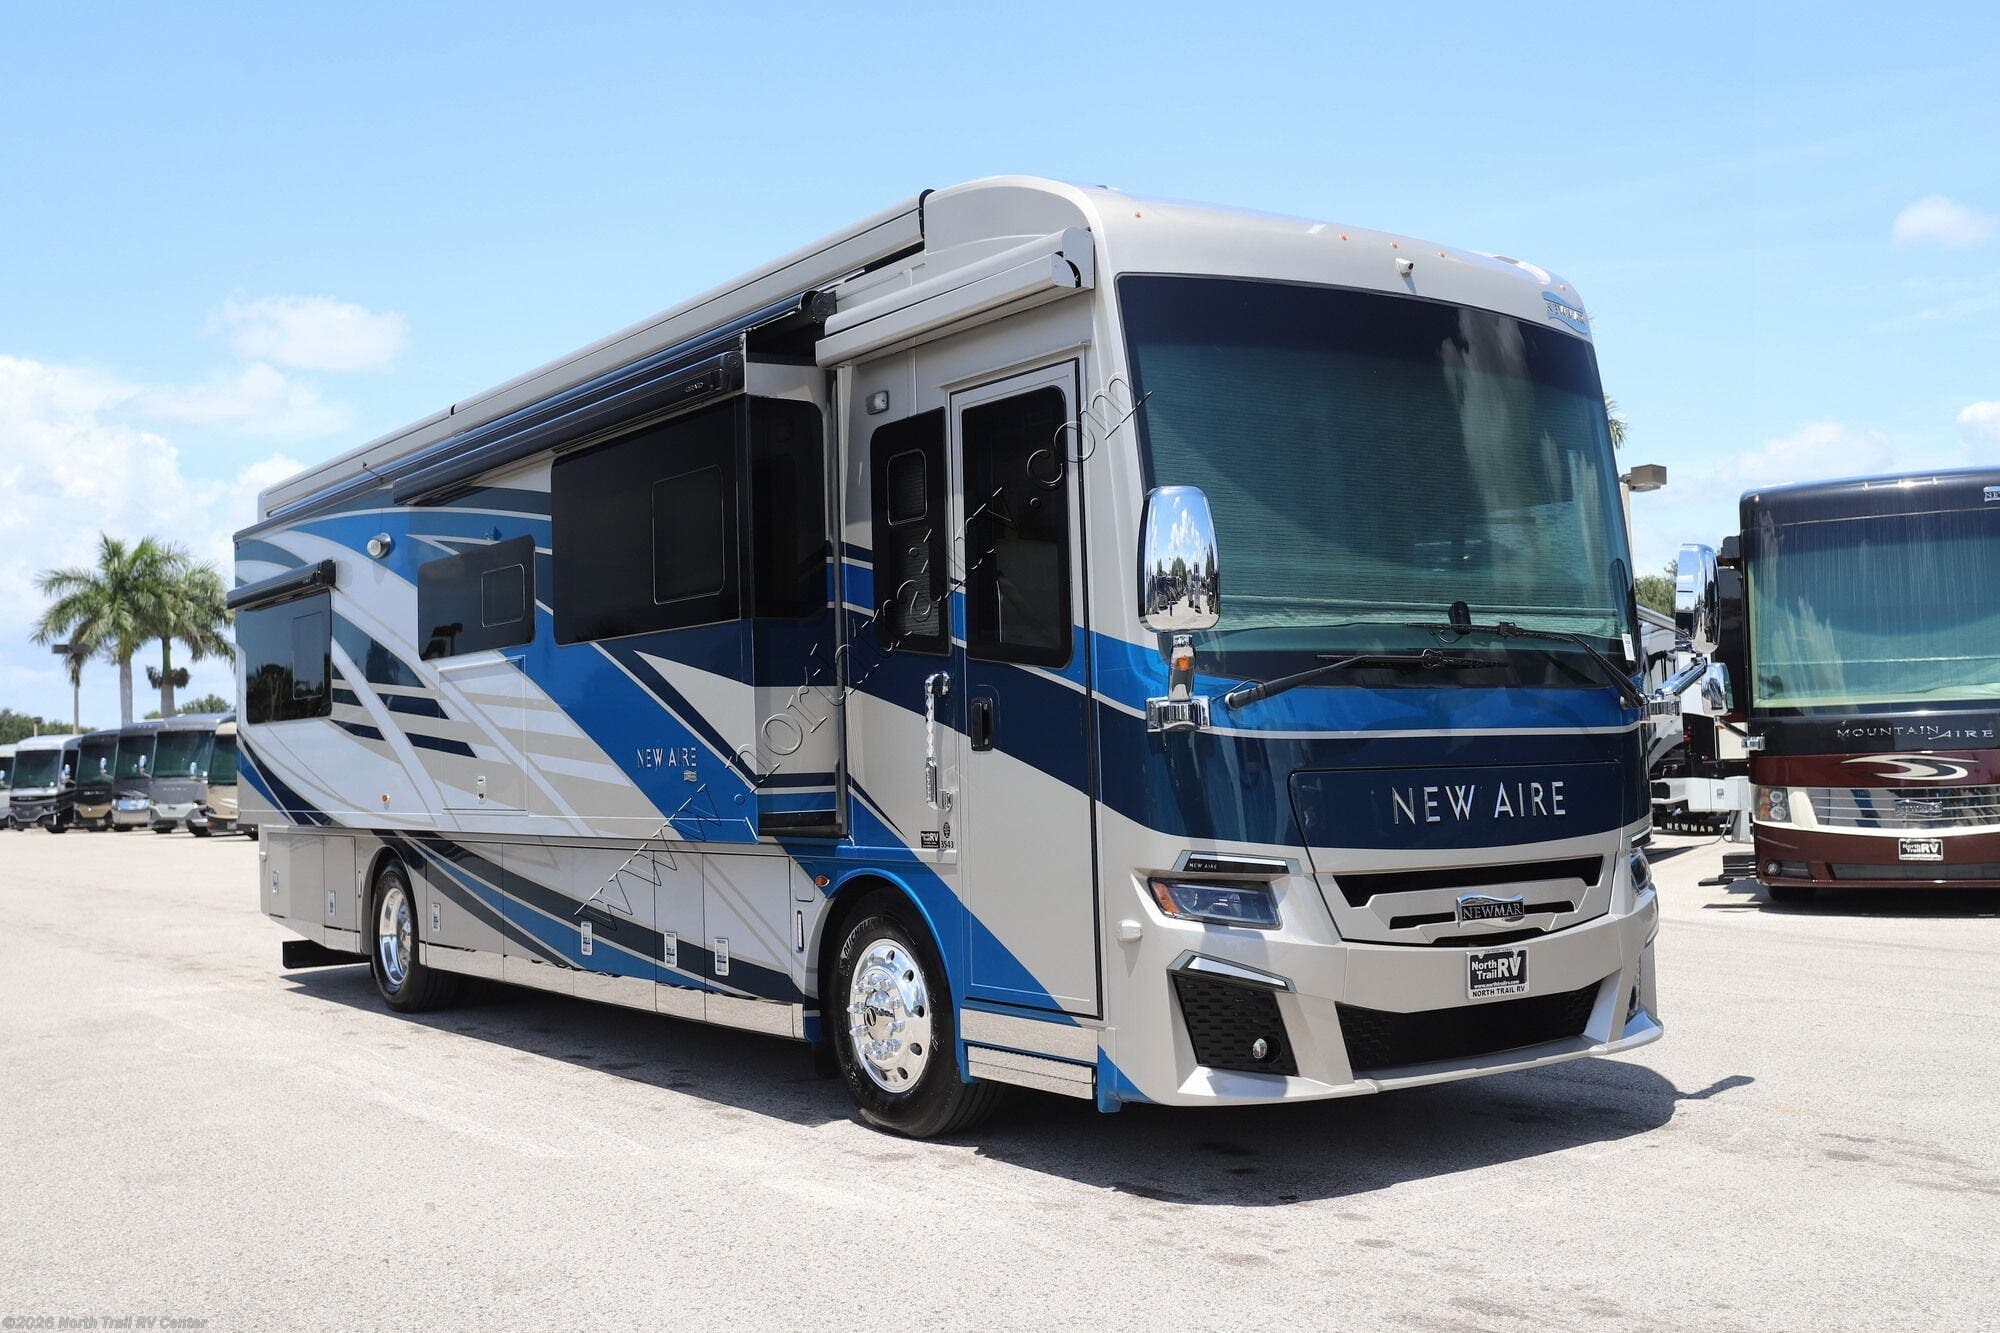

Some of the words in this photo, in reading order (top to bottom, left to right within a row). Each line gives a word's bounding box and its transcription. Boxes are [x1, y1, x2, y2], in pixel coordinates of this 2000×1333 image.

[1836, 725, 1939, 738] MOUNTAIN
[1927, 729, 1994, 740] AIRE
[636, 747, 663, 768] NEW
[668, 747, 697, 767] AIRE
[1391, 784, 1475, 825] NEW
[1493, 781, 1566, 818] AIRE
[1666, 822, 1713, 833] NEWMAR
[1920, 843, 1939, 853] RV
[1463, 903, 1523, 919] NEWMAR
[1472, 960, 1497, 970] North
[1498, 957, 1521, 977] RV
[1476, 970, 1497, 979] Trail
[1473, 989, 1495, 997] NORTH
